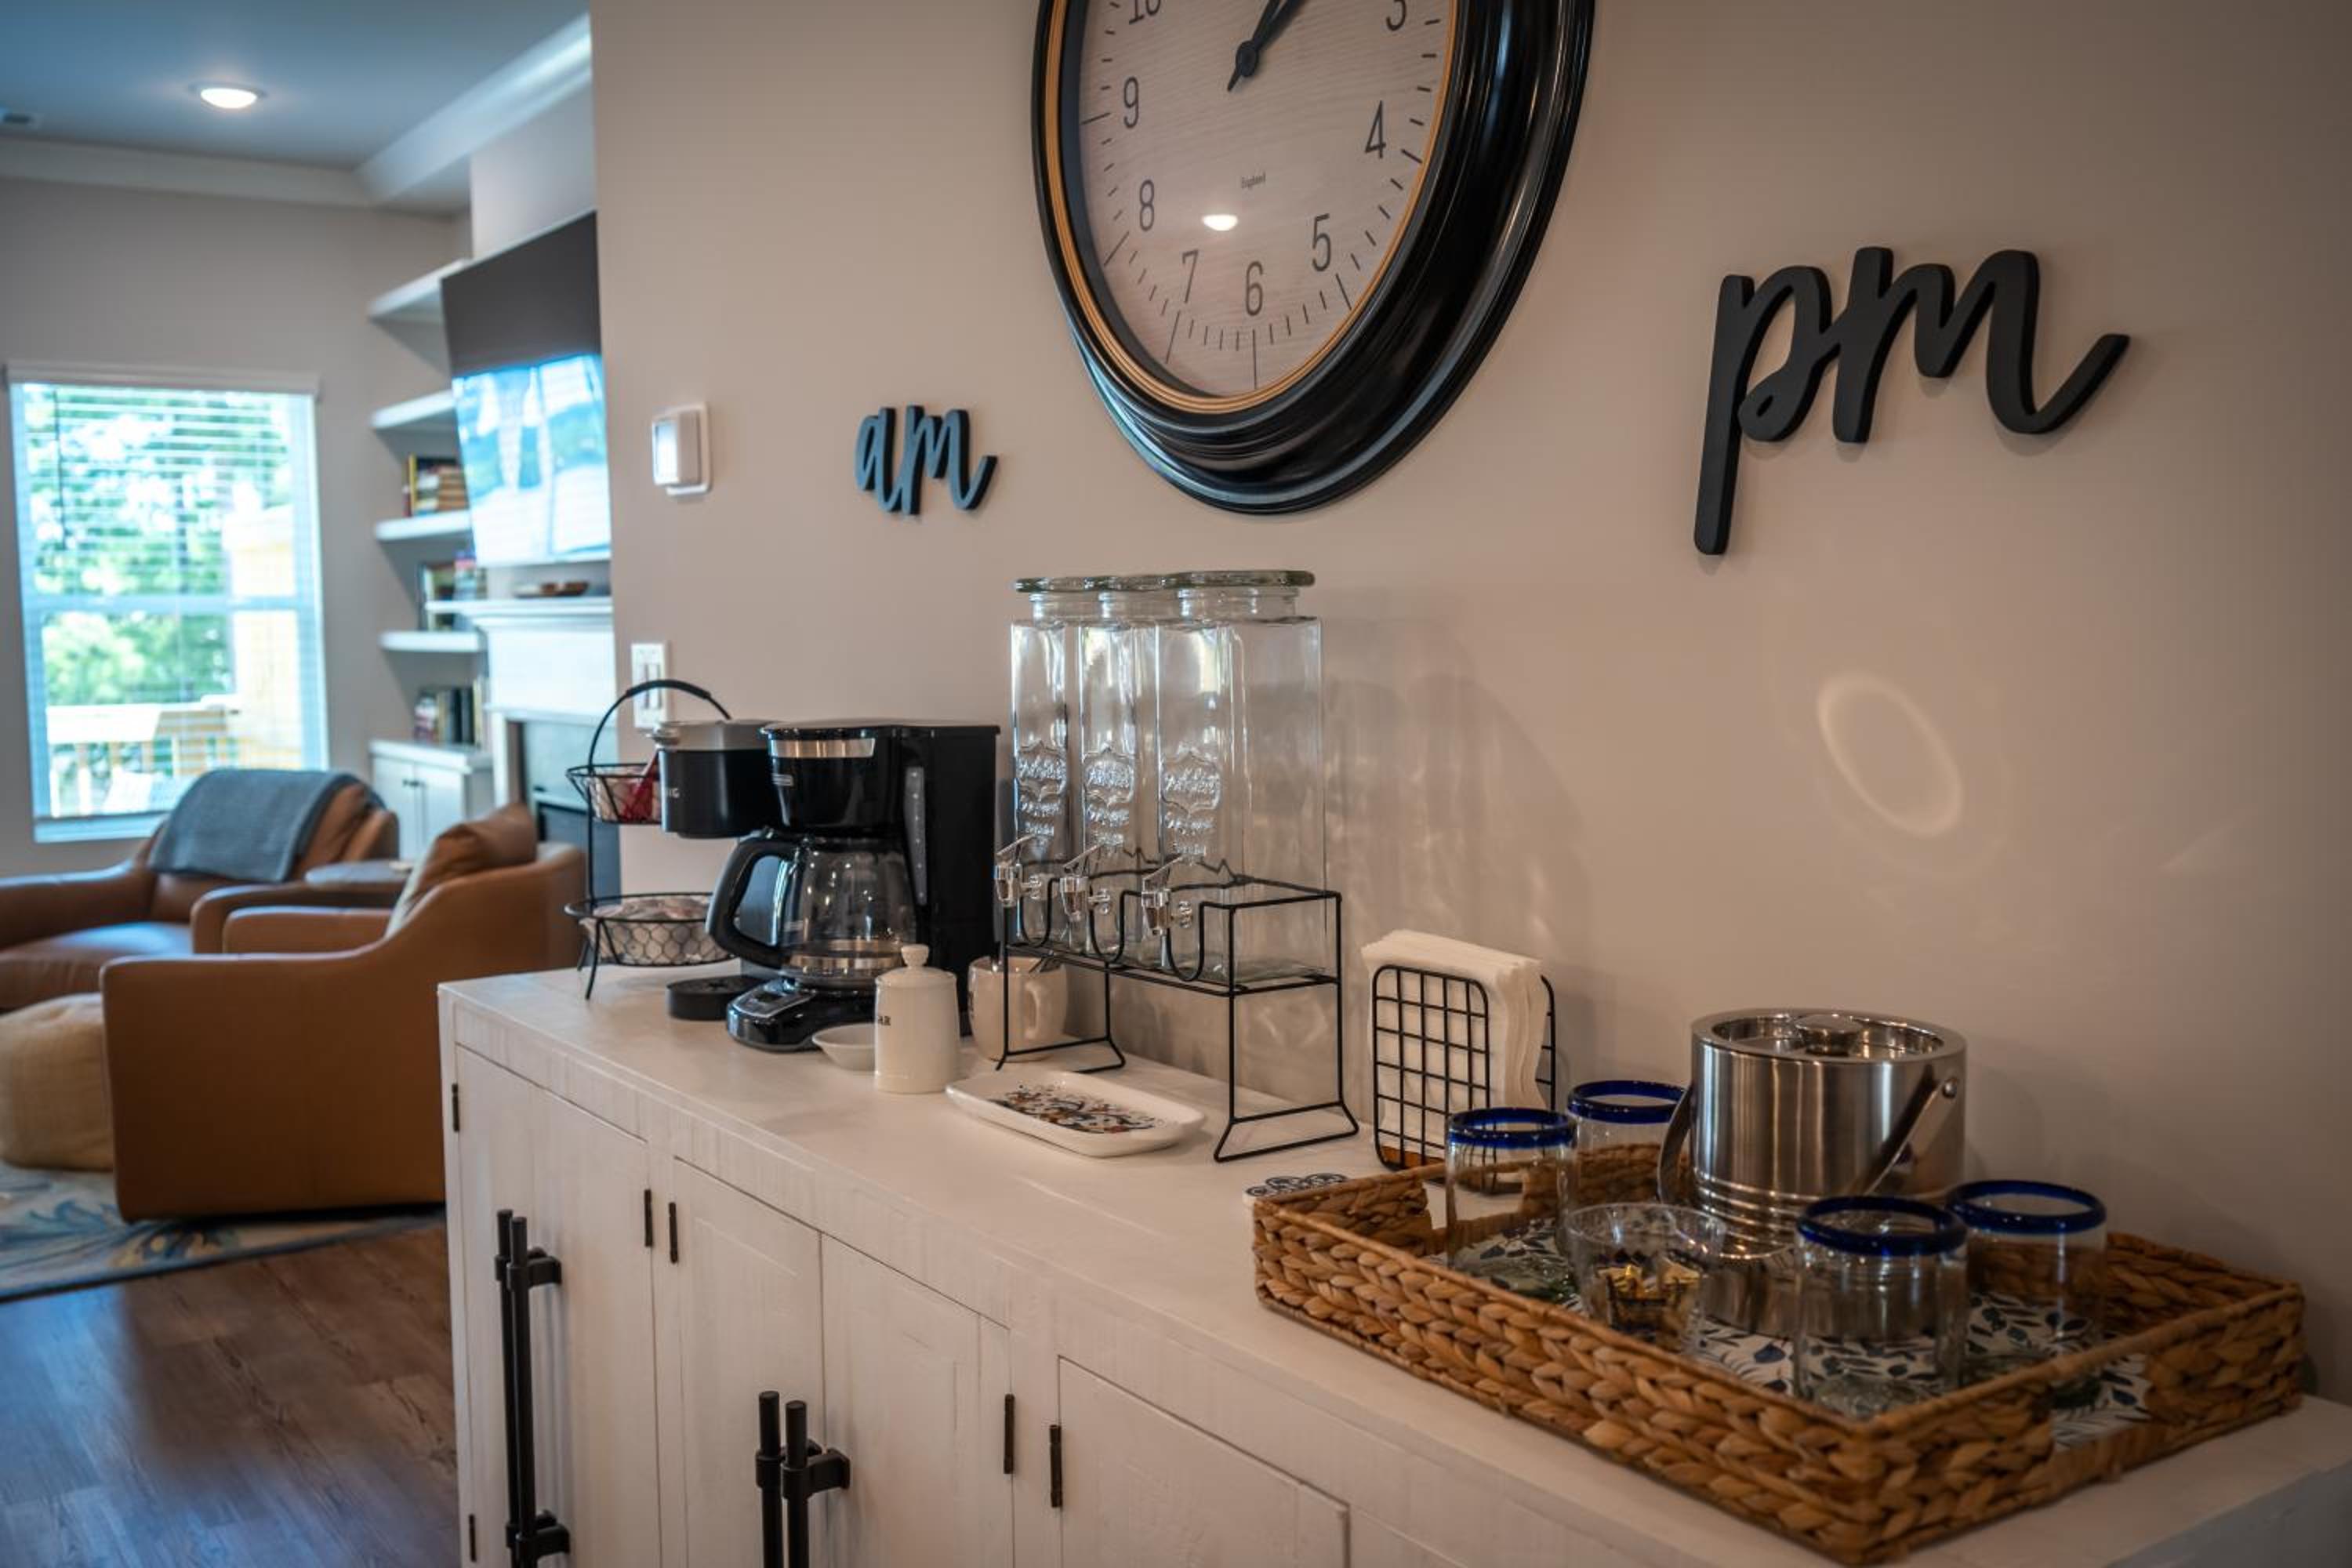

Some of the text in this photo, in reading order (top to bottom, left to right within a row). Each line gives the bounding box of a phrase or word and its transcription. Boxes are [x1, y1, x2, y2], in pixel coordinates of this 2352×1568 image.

[1123, 77, 1139, 129] 9
[1365, 100, 1387, 159] 4
[1138, 180, 1155, 232] 8
[1312, 213, 1332, 272] 5
[1181, 249, 1200, 304] 7
[1244, 261, 1264, 315] 6
[1694, 246, 2130, 555] pm
[855, 405, 999, 515] am
